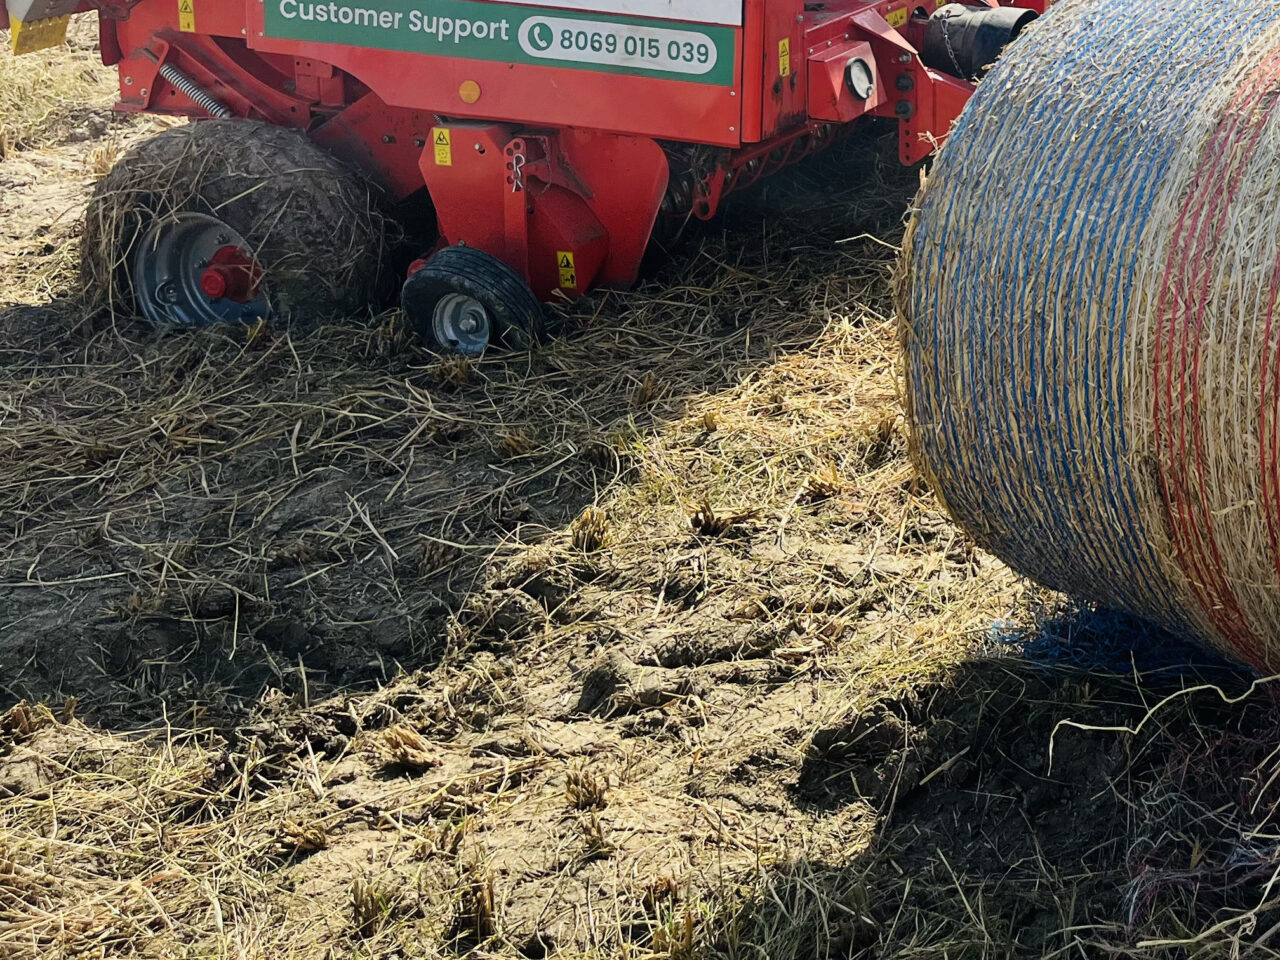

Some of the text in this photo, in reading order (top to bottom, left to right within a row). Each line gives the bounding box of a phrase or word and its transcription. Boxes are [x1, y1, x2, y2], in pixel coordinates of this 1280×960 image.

[408, 9, 510, 44] Support
[560, 28, 709, 64] 8069 015 039
